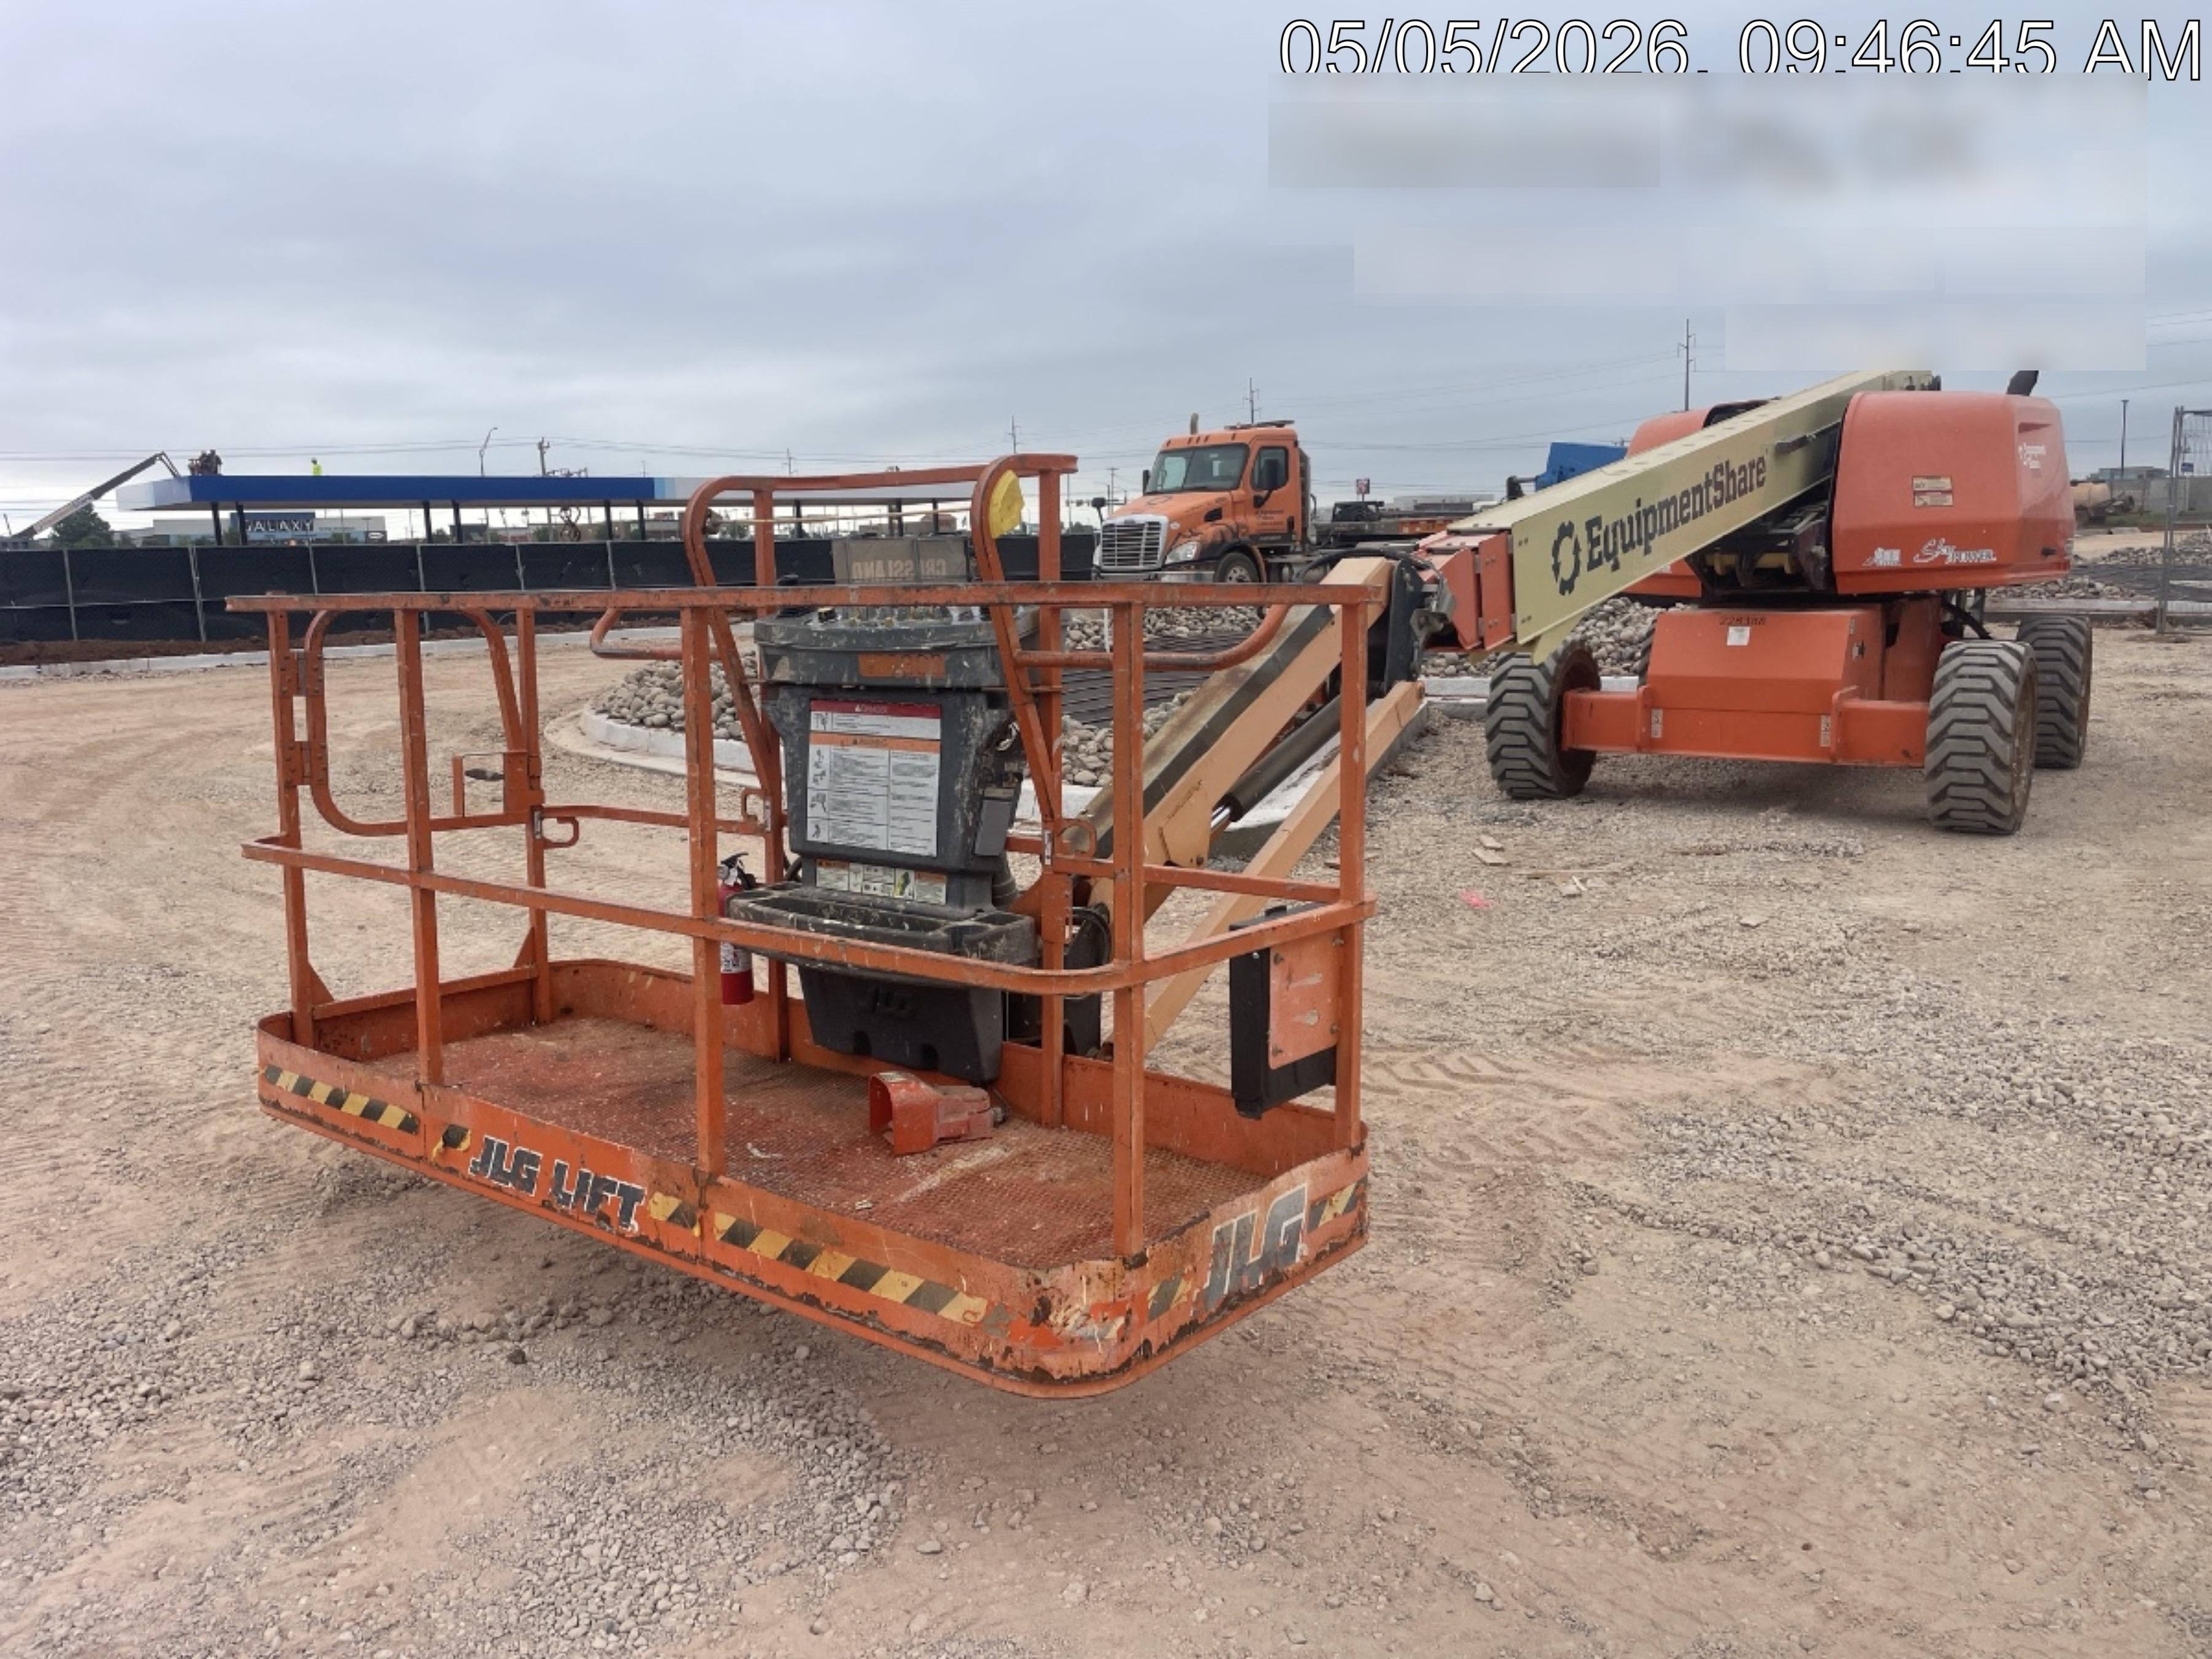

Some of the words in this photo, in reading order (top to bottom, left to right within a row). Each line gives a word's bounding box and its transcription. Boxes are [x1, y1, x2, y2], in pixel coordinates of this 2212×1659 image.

[1585, 455, 1767, 572] EquipmentShare
[468, 1135, 543, 1197] JLG
[549, 1158, 647, 1232] LIFT
[1191, 1183, 1308, 1317] JLG
